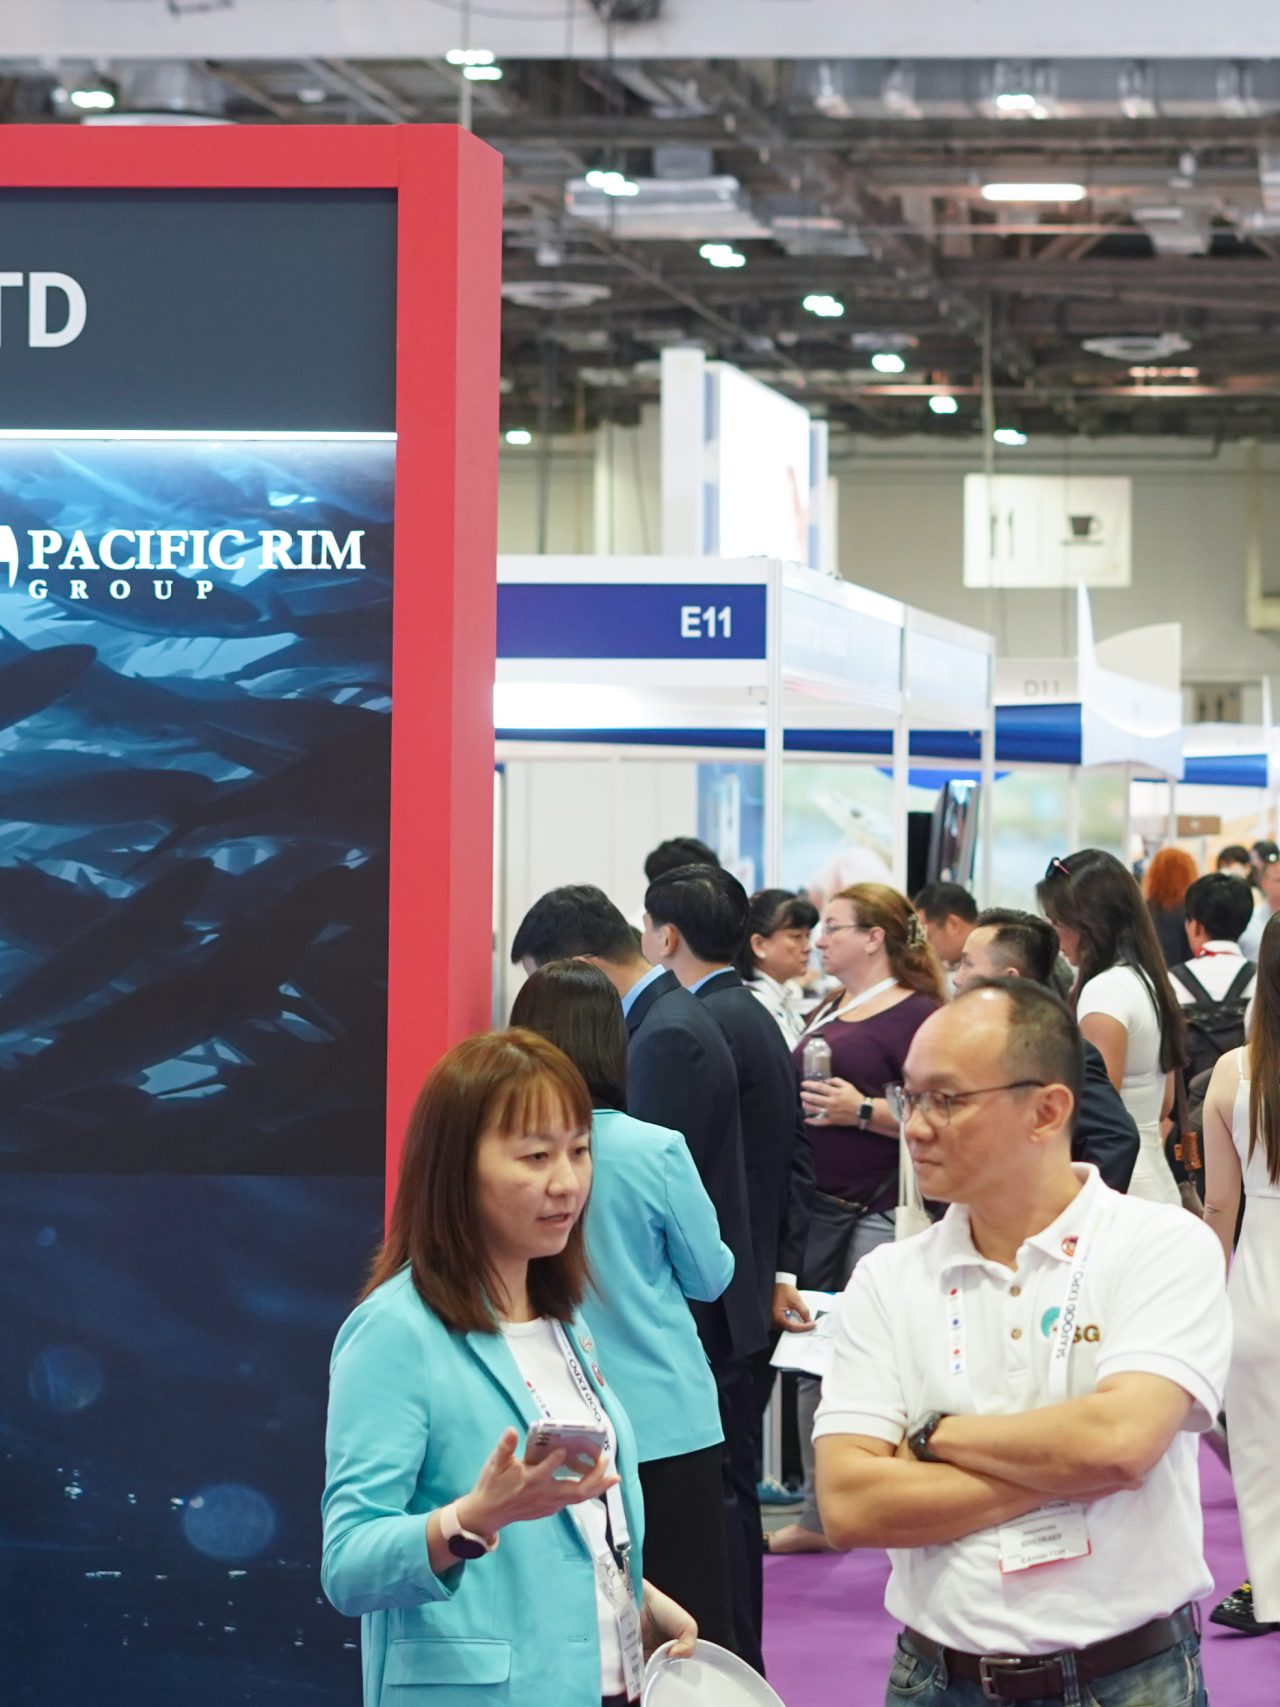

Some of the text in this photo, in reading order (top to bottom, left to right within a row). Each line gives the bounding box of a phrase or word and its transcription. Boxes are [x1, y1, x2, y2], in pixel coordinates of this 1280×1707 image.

[27, 529, 366, 570] PACIFIC RIM
[28, 579, 213, 599] GROUP
[681, 606, 731, 638] E11
[569, 1358, 587, 1391] EXPO
